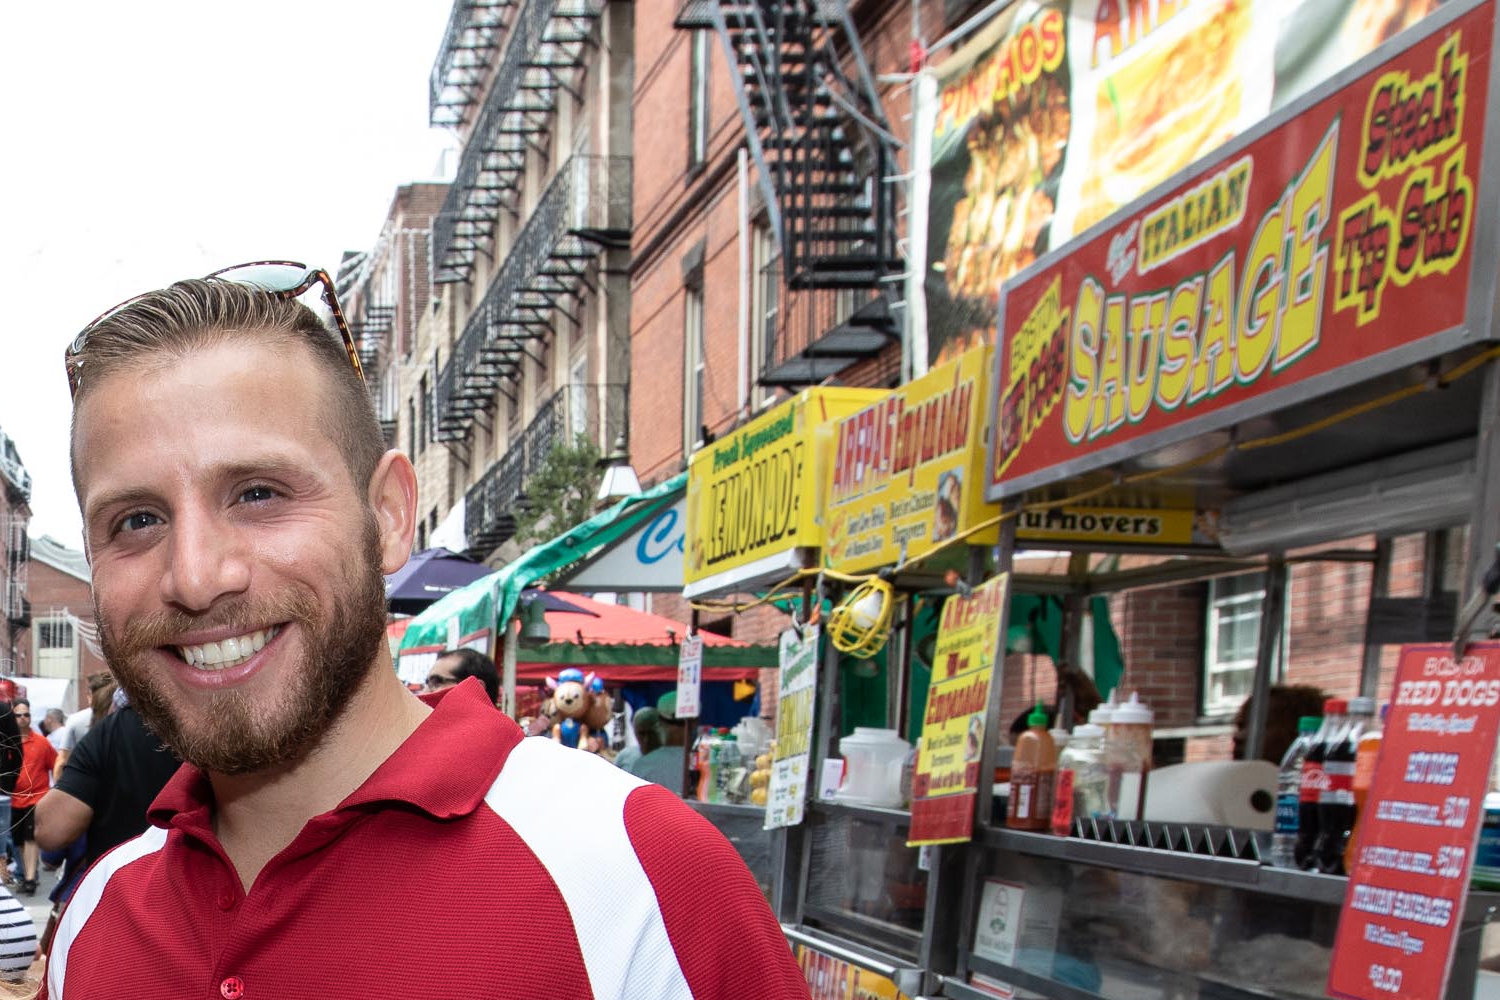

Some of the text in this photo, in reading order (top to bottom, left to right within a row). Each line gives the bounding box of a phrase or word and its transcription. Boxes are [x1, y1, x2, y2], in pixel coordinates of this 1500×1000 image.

[1361, 38, 1463, 182] Steak
[1064, 113, 1340, 443] SAUSAGE
[1140, 164, 1250, 270] ITALIAN
[1337, 156, 1470, 318] Tip Sub
[706, 441, 804, 565] LEMONADE
[1395, 680, 1500, 707] RED DOGS
